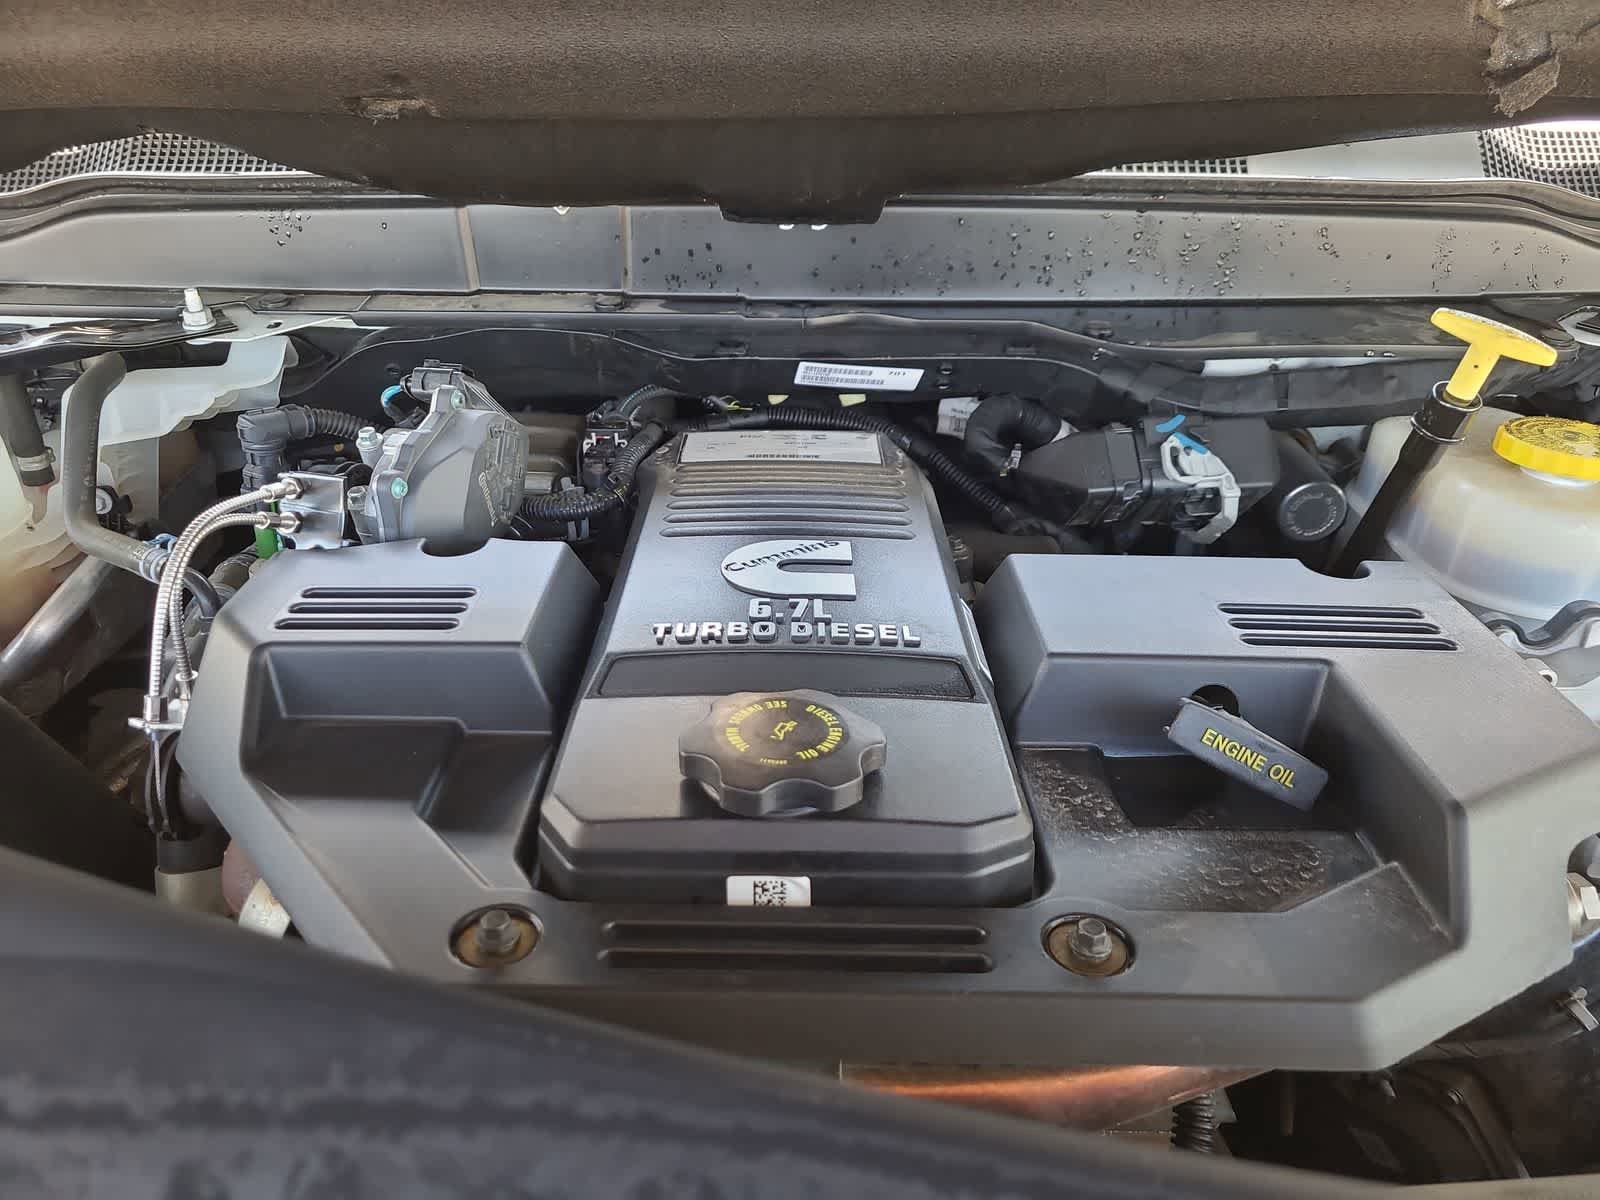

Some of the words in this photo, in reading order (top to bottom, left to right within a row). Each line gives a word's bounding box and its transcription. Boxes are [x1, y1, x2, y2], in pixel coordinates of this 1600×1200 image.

[724, 540, 841, 572] Cummins
[749, 598, 832, 624] 6.7L
[652, 621, 779, 645] TURBO
[790, 621, 921, 648] DIESEL
[805, 704, 840, 727] DIESEL
[816, 727, 843, 753] ENGINE
[795, 748, 819, 760] OIL
[1201, 727, 1268, 773] ENGINE
[1267, 762, 1297, 789] OIL
